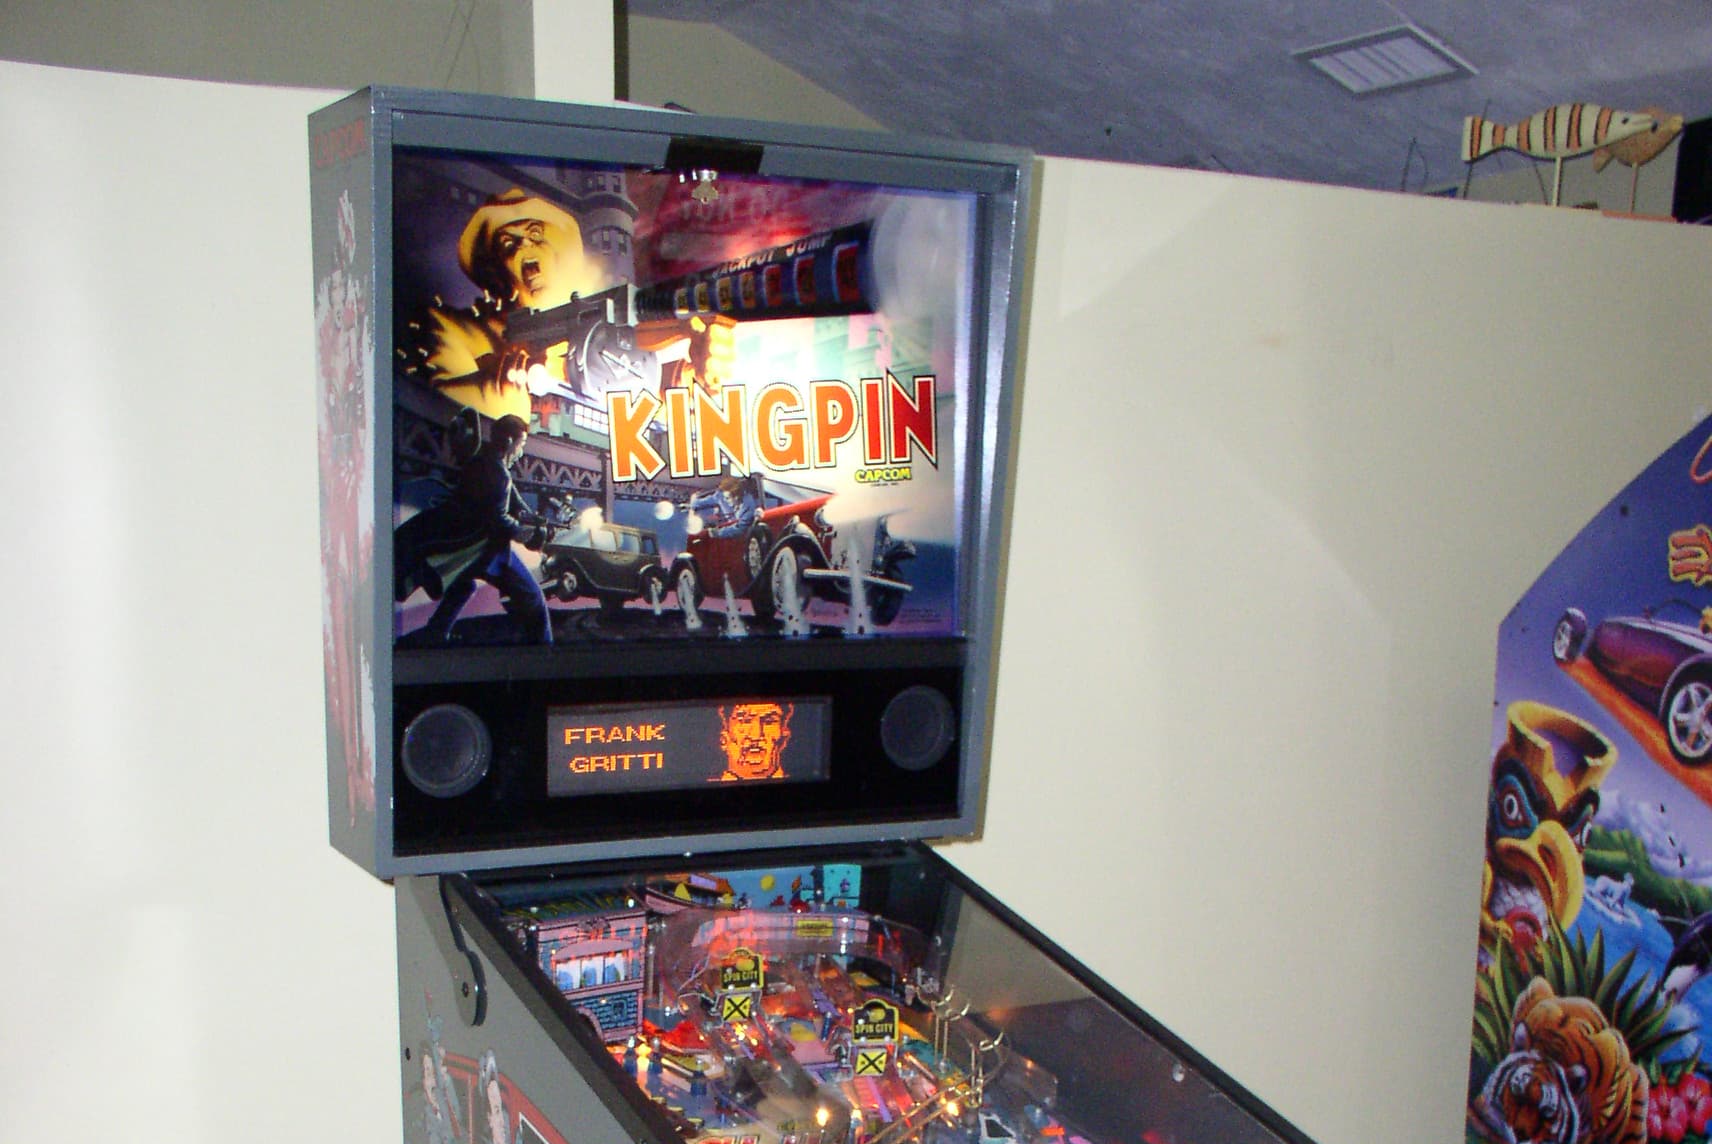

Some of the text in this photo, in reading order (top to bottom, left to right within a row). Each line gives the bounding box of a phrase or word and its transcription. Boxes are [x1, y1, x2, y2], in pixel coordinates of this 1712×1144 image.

[606, 368, 938, 483] KINGPIN
[855, 466, 912, 483] CAPCOM
[564, 724, 666, 745] FRANK
[569, 753, 664, 774] GRITTI
